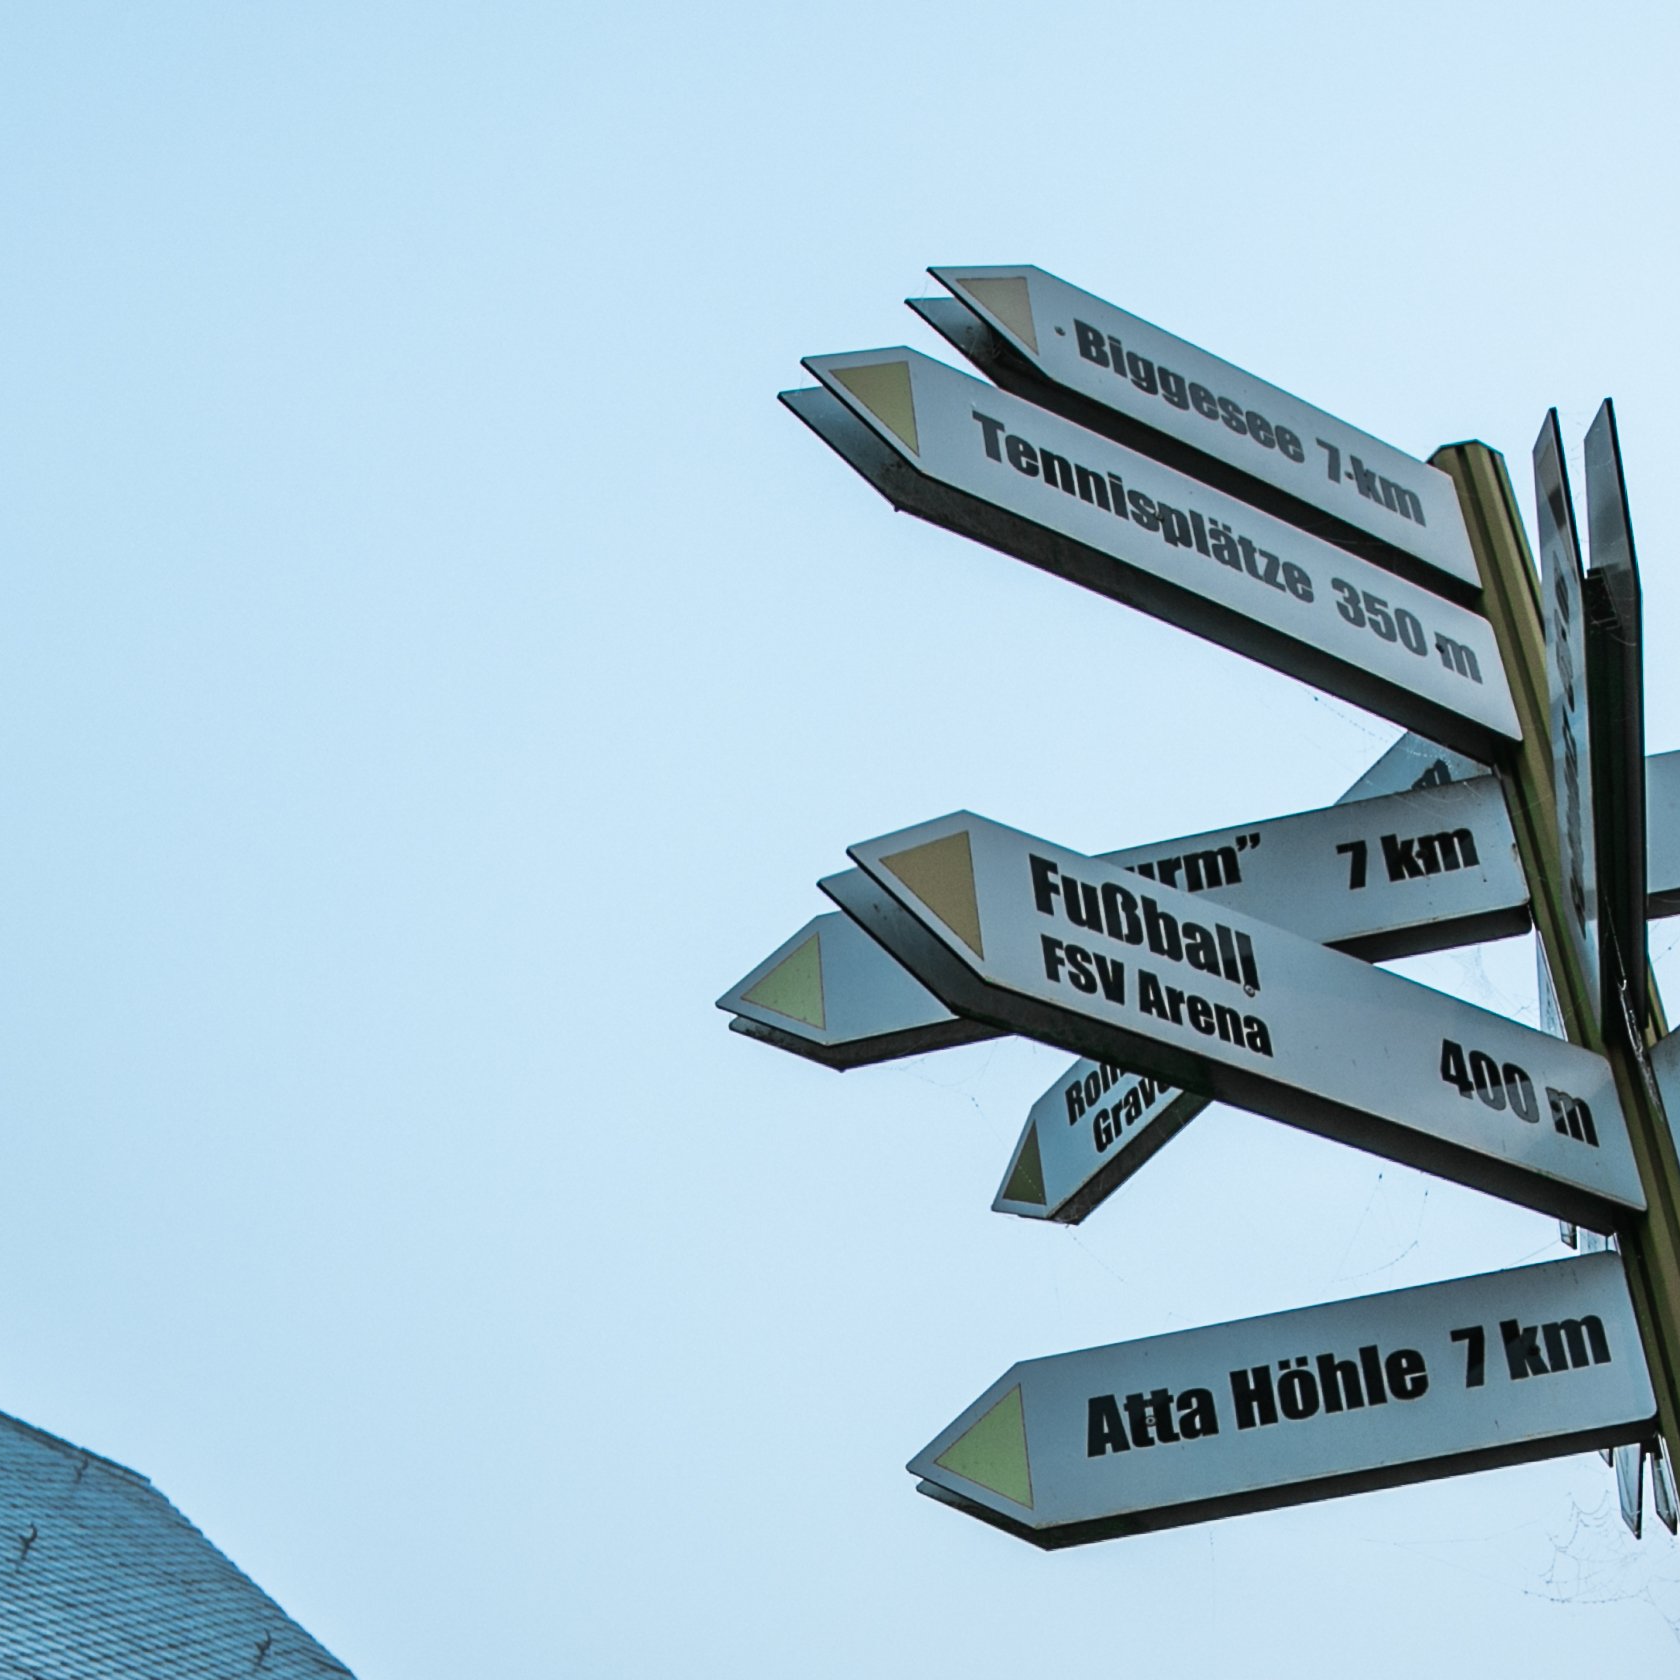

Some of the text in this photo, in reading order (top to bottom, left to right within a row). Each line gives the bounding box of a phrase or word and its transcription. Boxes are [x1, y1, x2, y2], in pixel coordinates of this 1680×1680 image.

[1074, 320, 1425, 527] Biggesee 7 km
[972, 410, 1483, 684] Tennisplätze 350 m
[1029, 853, 1260, 992] Fußball
[1336, 841, 1368, 889] 7
[1379, 827, 1479, 882] km
[1041, 935, 1273, 1057] FSV Arena
[1440, 1039, 1600, 1149] 400 m
[1086, 1313, 1610, 1458] Atta Höhle 7 km
